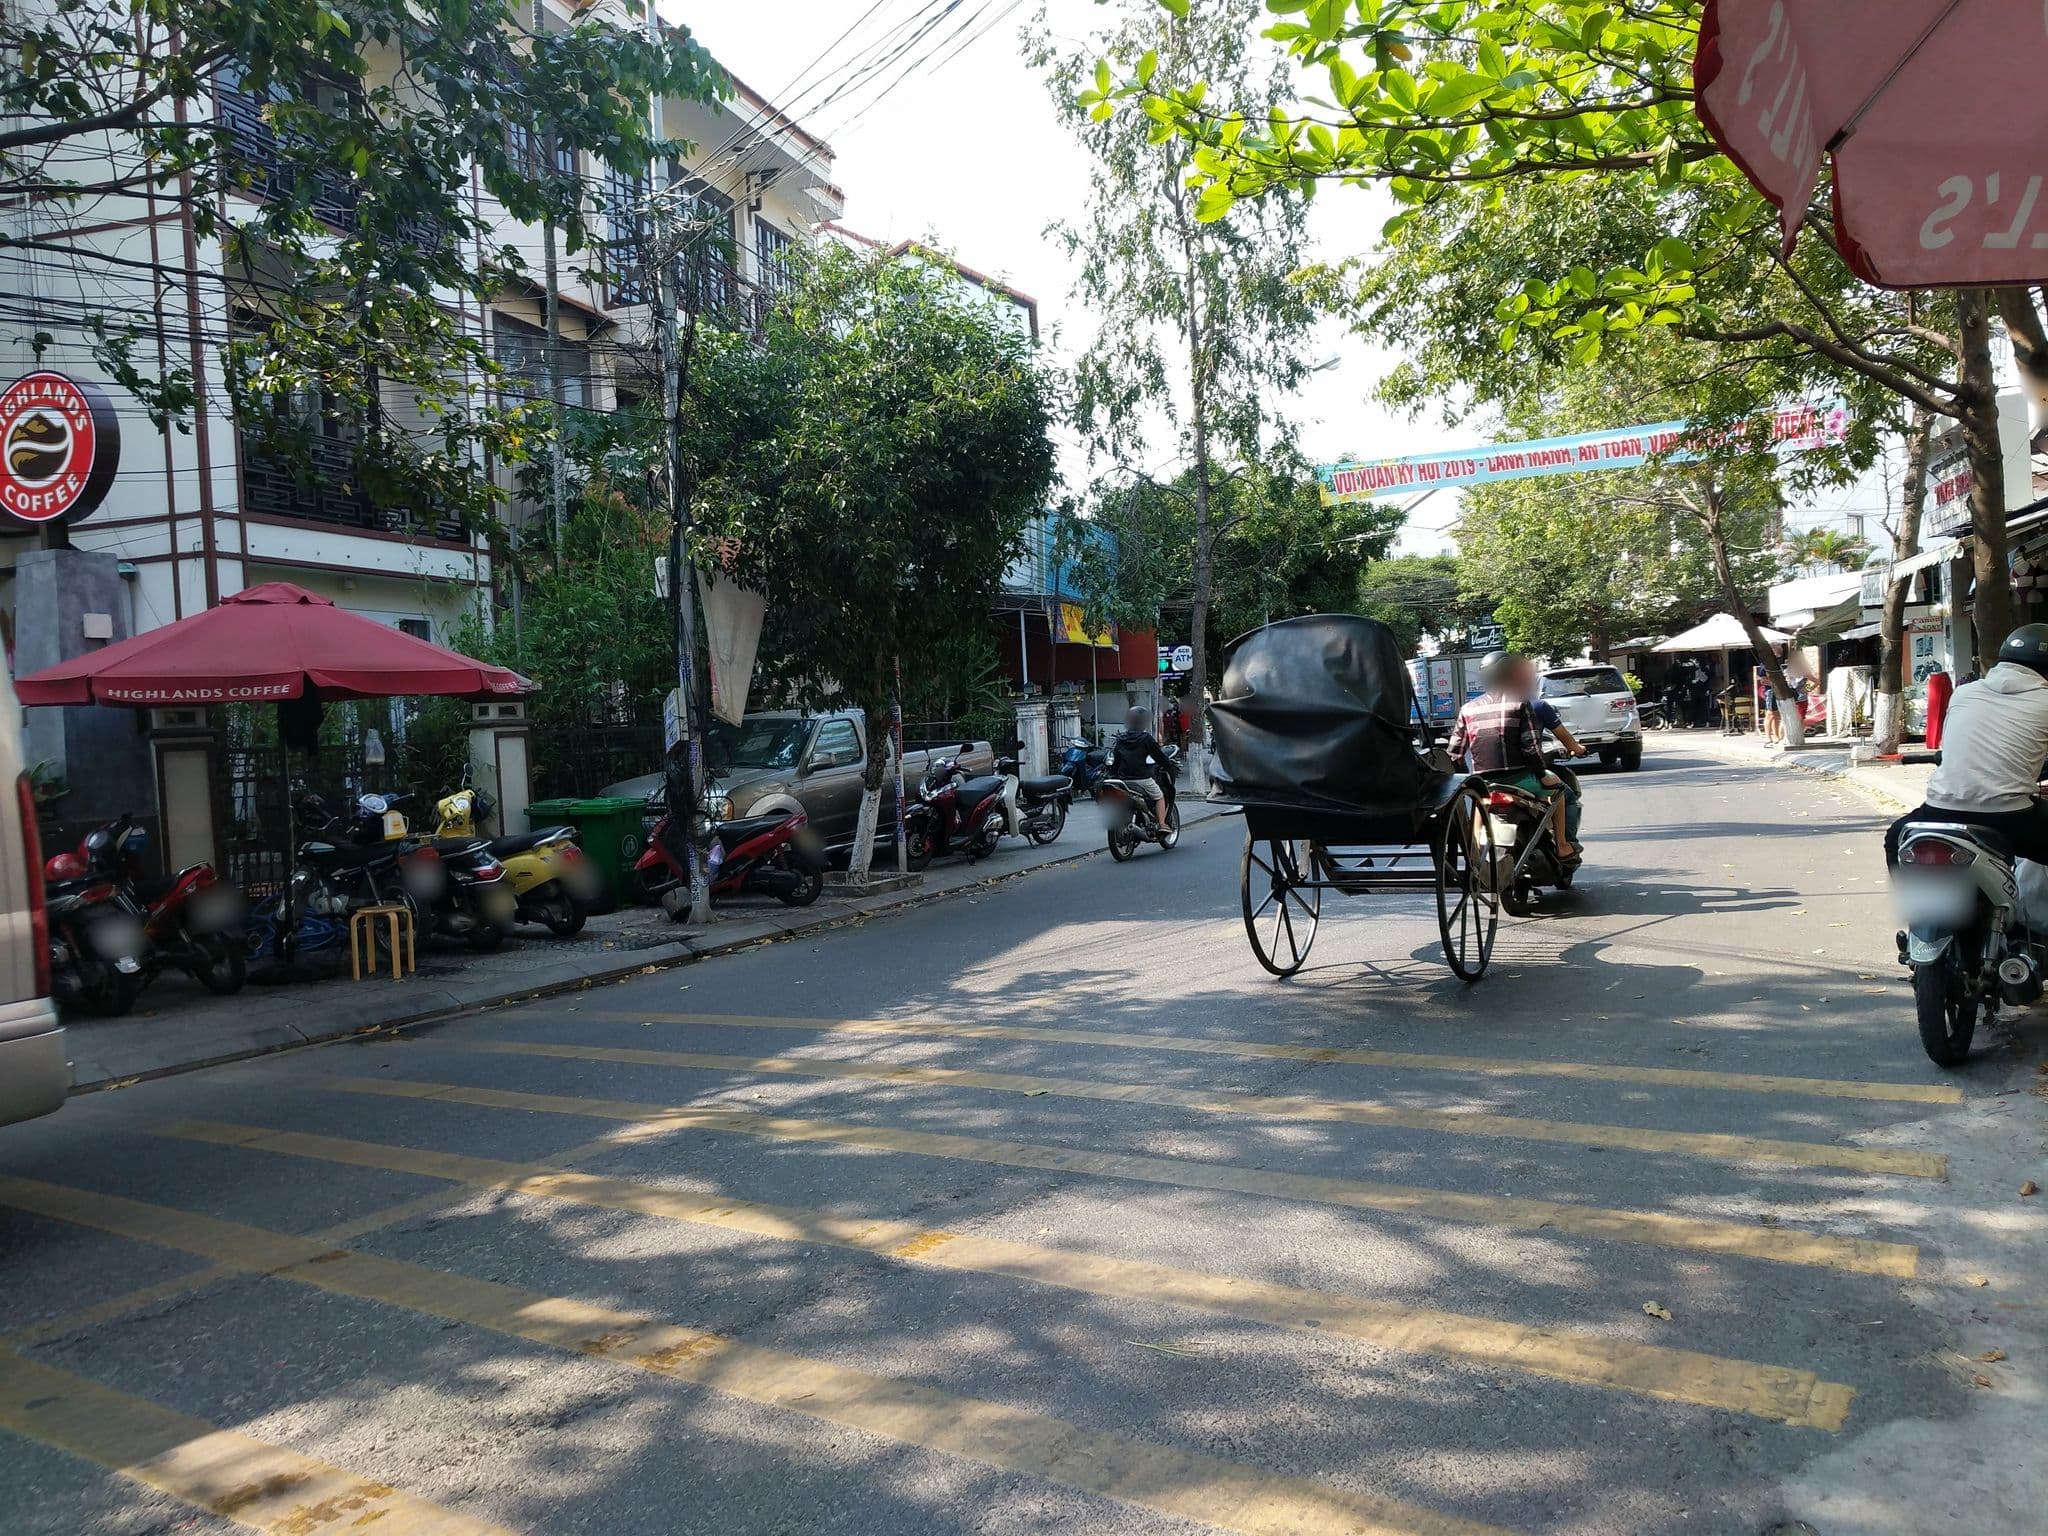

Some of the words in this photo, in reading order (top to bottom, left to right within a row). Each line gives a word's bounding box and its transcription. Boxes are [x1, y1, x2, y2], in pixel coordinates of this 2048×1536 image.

[0, 382, 88, 437] IGHLANDS
[4, 473, 80, 512] COFFEE
[1334, 472, 1358, 495] VUI
[1443, 458, 1476, 478] 2019
[107, 687, 223, 699] HIGHLANDS
[228, 684, 291, 697] COFFEE
